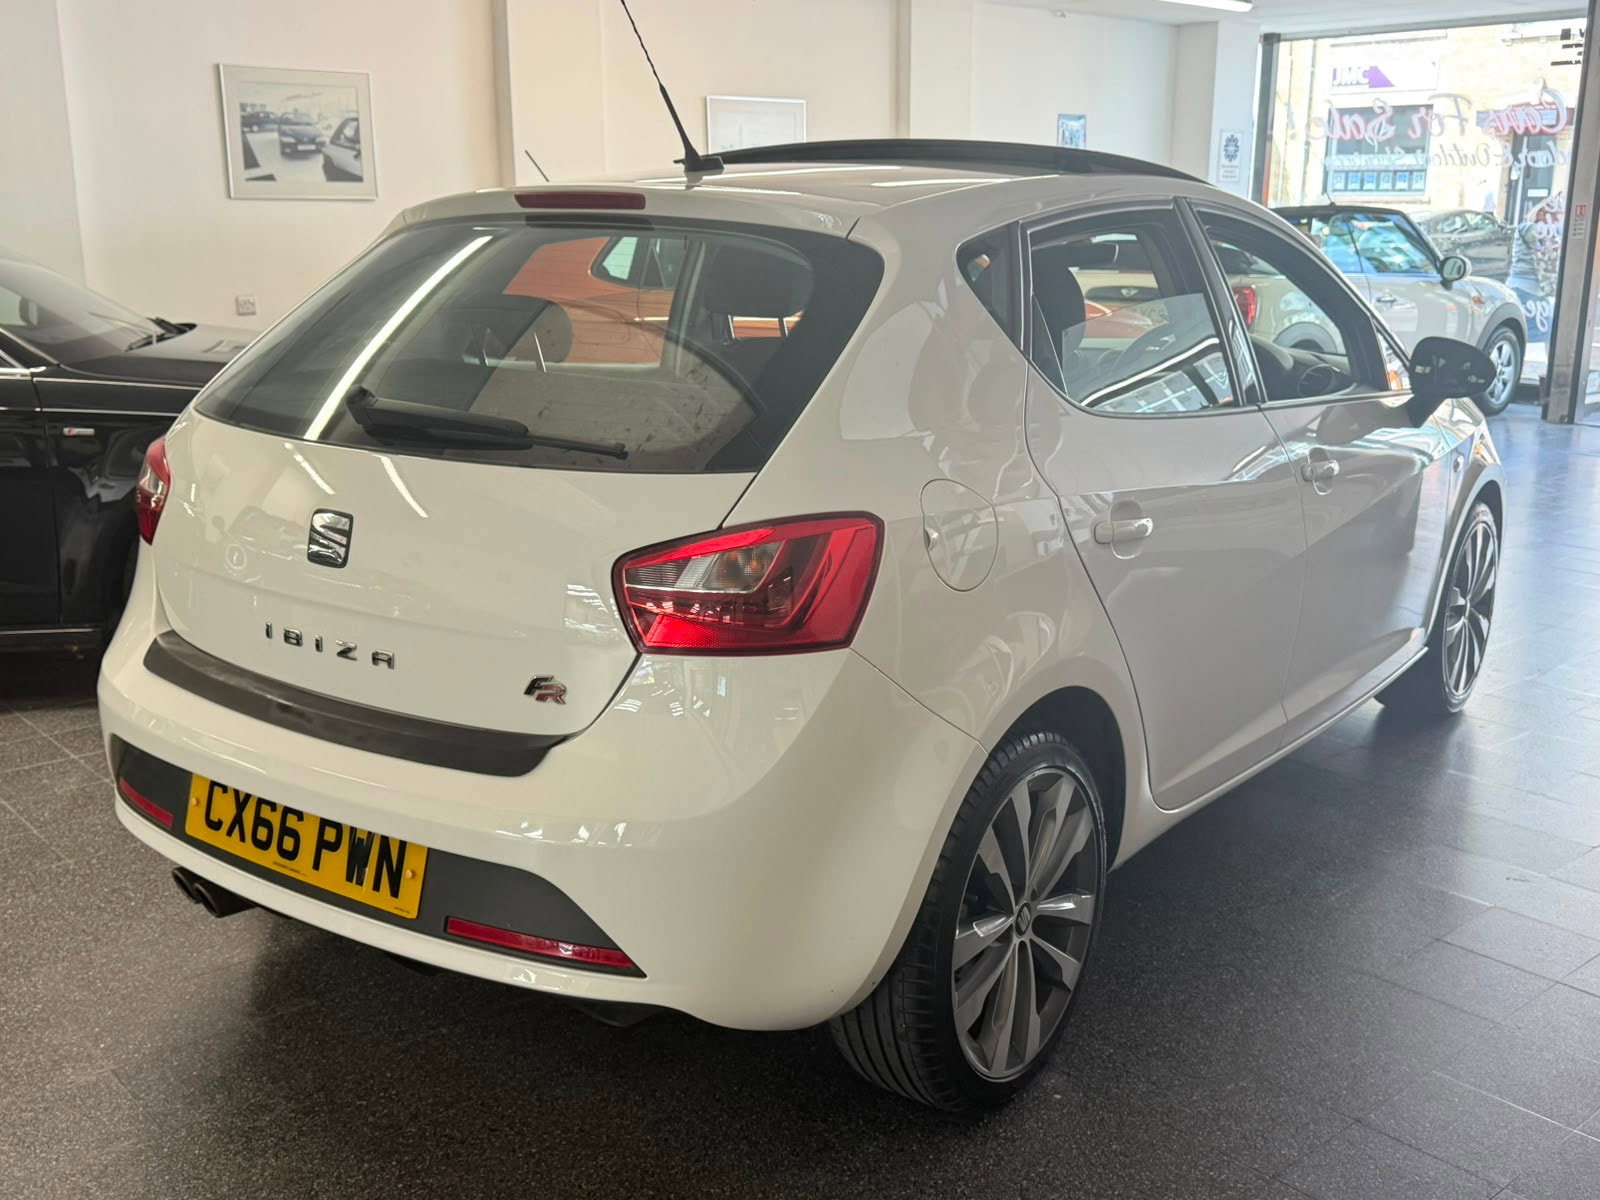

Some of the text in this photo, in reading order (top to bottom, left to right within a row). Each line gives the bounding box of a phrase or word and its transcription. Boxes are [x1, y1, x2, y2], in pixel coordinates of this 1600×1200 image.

[265, 622, 395, 670] IBIZA
[523, 675, 567, 705] FR
[204, 780, 407, 899] CX66 PWN
